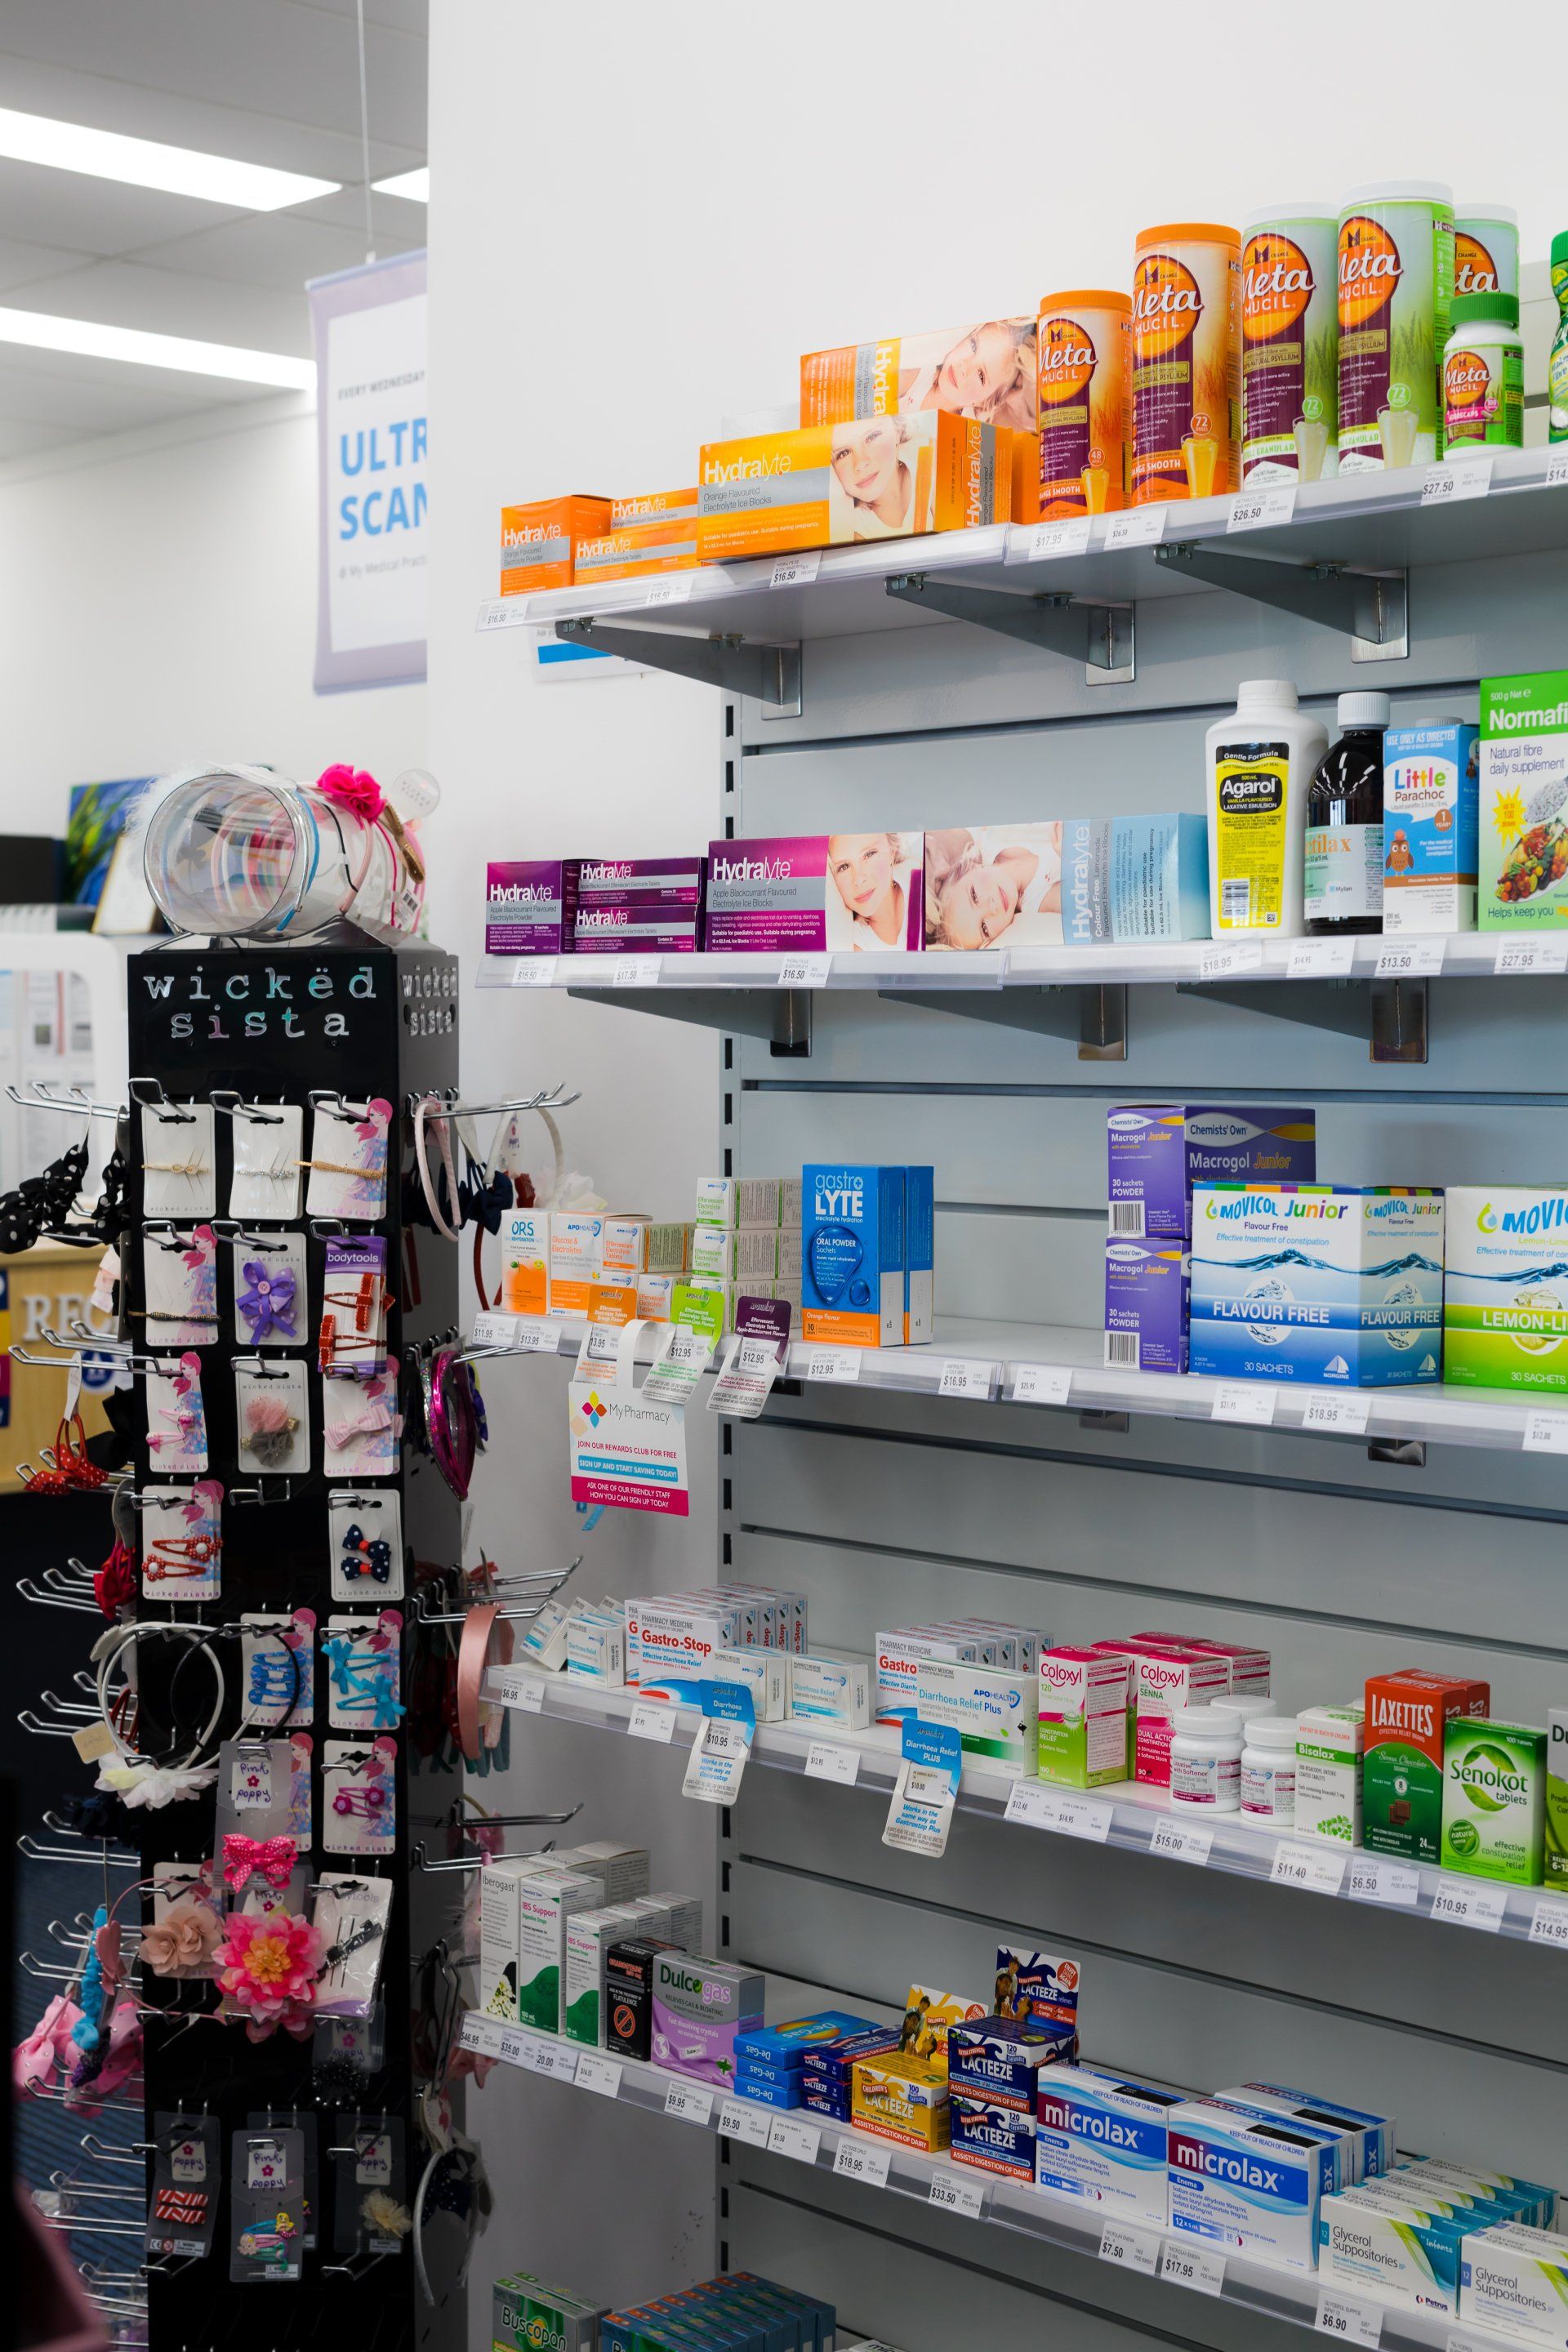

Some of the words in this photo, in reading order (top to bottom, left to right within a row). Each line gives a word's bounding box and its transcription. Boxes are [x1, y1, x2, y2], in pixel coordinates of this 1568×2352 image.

[1245, 296, 1291, 313] MUCIL
[1135, 317, 1178, 332] MUCIL
[1042, 368, 1078, 385] MUCIL
[704, 452, 791, 486] Hydralyte
[703, 490, 728, 502] Orange
[730, 487, 760, 500] Flavoured
[1423, 482, 1454, 495] $27.50
[612, 497, 666, 519] Hydralyte
[703, 500, 737, 514] Electrolyte
[737, 498, 748, 507] Ice
[749, 495, 772, 506] Blocks
[1233, 507, 1262, 521] $26.50
[504, 522, 561, 550] Hydralyte
[577, 537, 631, 561] Hydralyte
[773, 570, 796, 583] $16.50
[1489, 709, 1568, 732] Normafi
[1224, 753, 1246, 761] Gentle
[1248, 750, 1279, 760] Formula
[1490, 746, 1522, 760] Natural
[1522, 744, 1543, 757] fibre
[1490, 762, 1510, 776] daily
[1512, 759, 1565, 773] supplement
[1221, 777, 1276, 795] Agarol
[1394, 766, 1446, 790] Little
[1395, 788, 1445, 802] Parachoc
[1094, 837, 1102, 879] Lemonade
[581, 862, 632, 881] Hydralyte
[713, 857, 791, 884] Hydralyte
[490, 882, 553, 902] Hydralyte
[712, 888, 729, 898] Apple
[729, 887, 765, 898] Blackcurrant
[766, 886, 797, 897] Flavoured
[1071, 826, 1092, 940] Hydralyte
[1094, 880, 1102, 902] Free
[712, 898, 741, 909] Electrolyte
[741, 898, 751, 907] Ice
[751, 898, 773, 907] Blocks
[1488, 906, 1510, 919] Helps
[1512, 906, 1532, 919] keep
[1535, 908, 1554, 919] you
[577, 908, 628, 928] Hydralyte
[1094, 903, 1102, 938] Colour
[1203, 956, 1232, 973] $18.95
[1381, 956, 1411, 969] $13.50
[1501, 954, 1534, 967] $27.95
[143, 965, 376, 1000] wickëd
[782, 969, 806, 980] $16.50
[170, 1004, 350, 1039] sista
[409, 1003, 453, 1036] sista
[1229, 1125, 1247, 1134] Own
[1189, 1152, 1250, 1169] Macrogol
[1254, 1153, 1292, 1169] Junior
[815, 1171, 864, 1197] gastro
[1112, 1178, 1121, 1187] 30
[1122, 1178, 1144, 1187] sachets
[1112, 1187, 1144, 1196] POWDER
[815, 1189, 863, 1218] LYTE
[1220, 1196, 1279, 1219] MOVICOL
[1285, 1200, 1349, 1218] Junior
[816, 1237, 831, 1246] ORAL
[832, 1239, 856, 1248] POWDER
[1216, 1233, 1244, 1243] Effective
[1245, 1235, 1276, 1244] treatment
[1286, 1237, 1330, 1246] constipation
[327, 1252, 379, 1265] bodytools
[1213, 1301, 1283, 1321] FLAVOUR
[1288, 1305, 1330, 1324] FREE
[742, 1352, 764, 1364] $12.95
[811, 1364, 834, 1374] $12.95
[1244, 1361, 1254, 1371] 30
[1255, 1363, 1294, 1374] SACHETS
[943, 1375, 967, 1387] $16.95
[577, 1441, 590, 1449] JOIN
[592, 1441, 604, 1450] OUR
[605, 1444, 633, 1454] REWARDS
[634, 1447, 649, 1456] CLUB
[650, 1449, 662, 1457] FOR
[663, 1450, 677, 1459] FREE
[579, 1459, 593, 1468] SIGN
[615, 1464, 632, 1473] START
[633, 1466, 655, 1476] SAVING
[655, 1469, 677, 1479] TODAY!
[586, 1481, 597, 1490] ASK
[597, 1483, 609, 1491] ONE
[609, 1484, 617, 1492] OF
[618, 1485, 629, 1494] OUR
[630, 1486, 655, 1497] FRIENDLY
[655, 1490, 670, 1499] STAFF
[590, 1491, 602, 1500] HOW
[602, 1493, 616, 1502] YOU
[616, 1494, 628, 1503] CAN
[629, 1495, 642, 1504] SIGN
[642, 1497, 649, 1505] UP
[650, 1499, 669, 1508] TODAY
[641, 1615, 669, 1626] PHARMACY
[669, 1619, 693, 1630] MEDICINE
[642, 1629, 712, 1658] Gastro-Stop
[1040, 1663, 1082, 1686] Coloxyl
[1140, 1665, 1185, 1689] Coloxyl
[919, 1689, 958, 1706] Diarrhoea
[960, 1697, 982, 1711] Relief
[984, 1703, 1002, 1715] Plus
[973, 1689, 1015, 1703] APOHEALTH
[1140, 1688, 1164, 1699] SENNA
[1371, 1694, 1434, 1737] LAXETTES
[707, 1734, 728, 1747] $10.95
[1298, 1744, 1335, 1760] Bisalax
[1450, 1759, 1529, 1793] Senokot
[1495, 1792, 1528, 1806] tablets
[1156, 1834, 1183, 1851] $15.00
[1277, 1863, 1306, 1878] $11.40
[523, 1902, 532, 1912] IBS
[532, 1904, 557, 1918] Support
[1436, 1896, 1467, 1914] $10.95
[660, 1964, 732, 2004] Dulcogas
[1021, 1983, 1058, 2001] LACTEEZE
[962, 2055, 1013, 2082] LACTEEZE
[951, 2084, 973, 2096] ASSISTS
[973, 2089, 1002, 2104] DIGESTION
[1003, 2096, 1010, 2105] OF
[1011, 2098, 1027, 2110] DAIRY
[865, 2094, 915, 2121] LACTEEZE
[1045, 2103, 1138, 2149] microlax
[964, 2123, 1015, 2149] LACTEEZE
[839, 2155, 863, 2172] $18.95
[1177, 2143, 1279, 2193] microlax
[931, 2187, 956, 2203] $33.50
[1332, 2225, 1371, 2247] Glycerol
[1102, 2242, 1124, 2258] $7.50
[1332, 2238, 1398, 2269] Suppositories
[1165, 2260, 1193, 2278] $17.95
[1475, 2266, 1517, 2289] Glycerol
[1425, 2297, 1448, 2310] Petrus
[1475, 2279, 1547, 2312] Suppositories
[501, 2305, 567, 2352] Buscopan
[1322, 2314, 1347, 2332] $6.90
